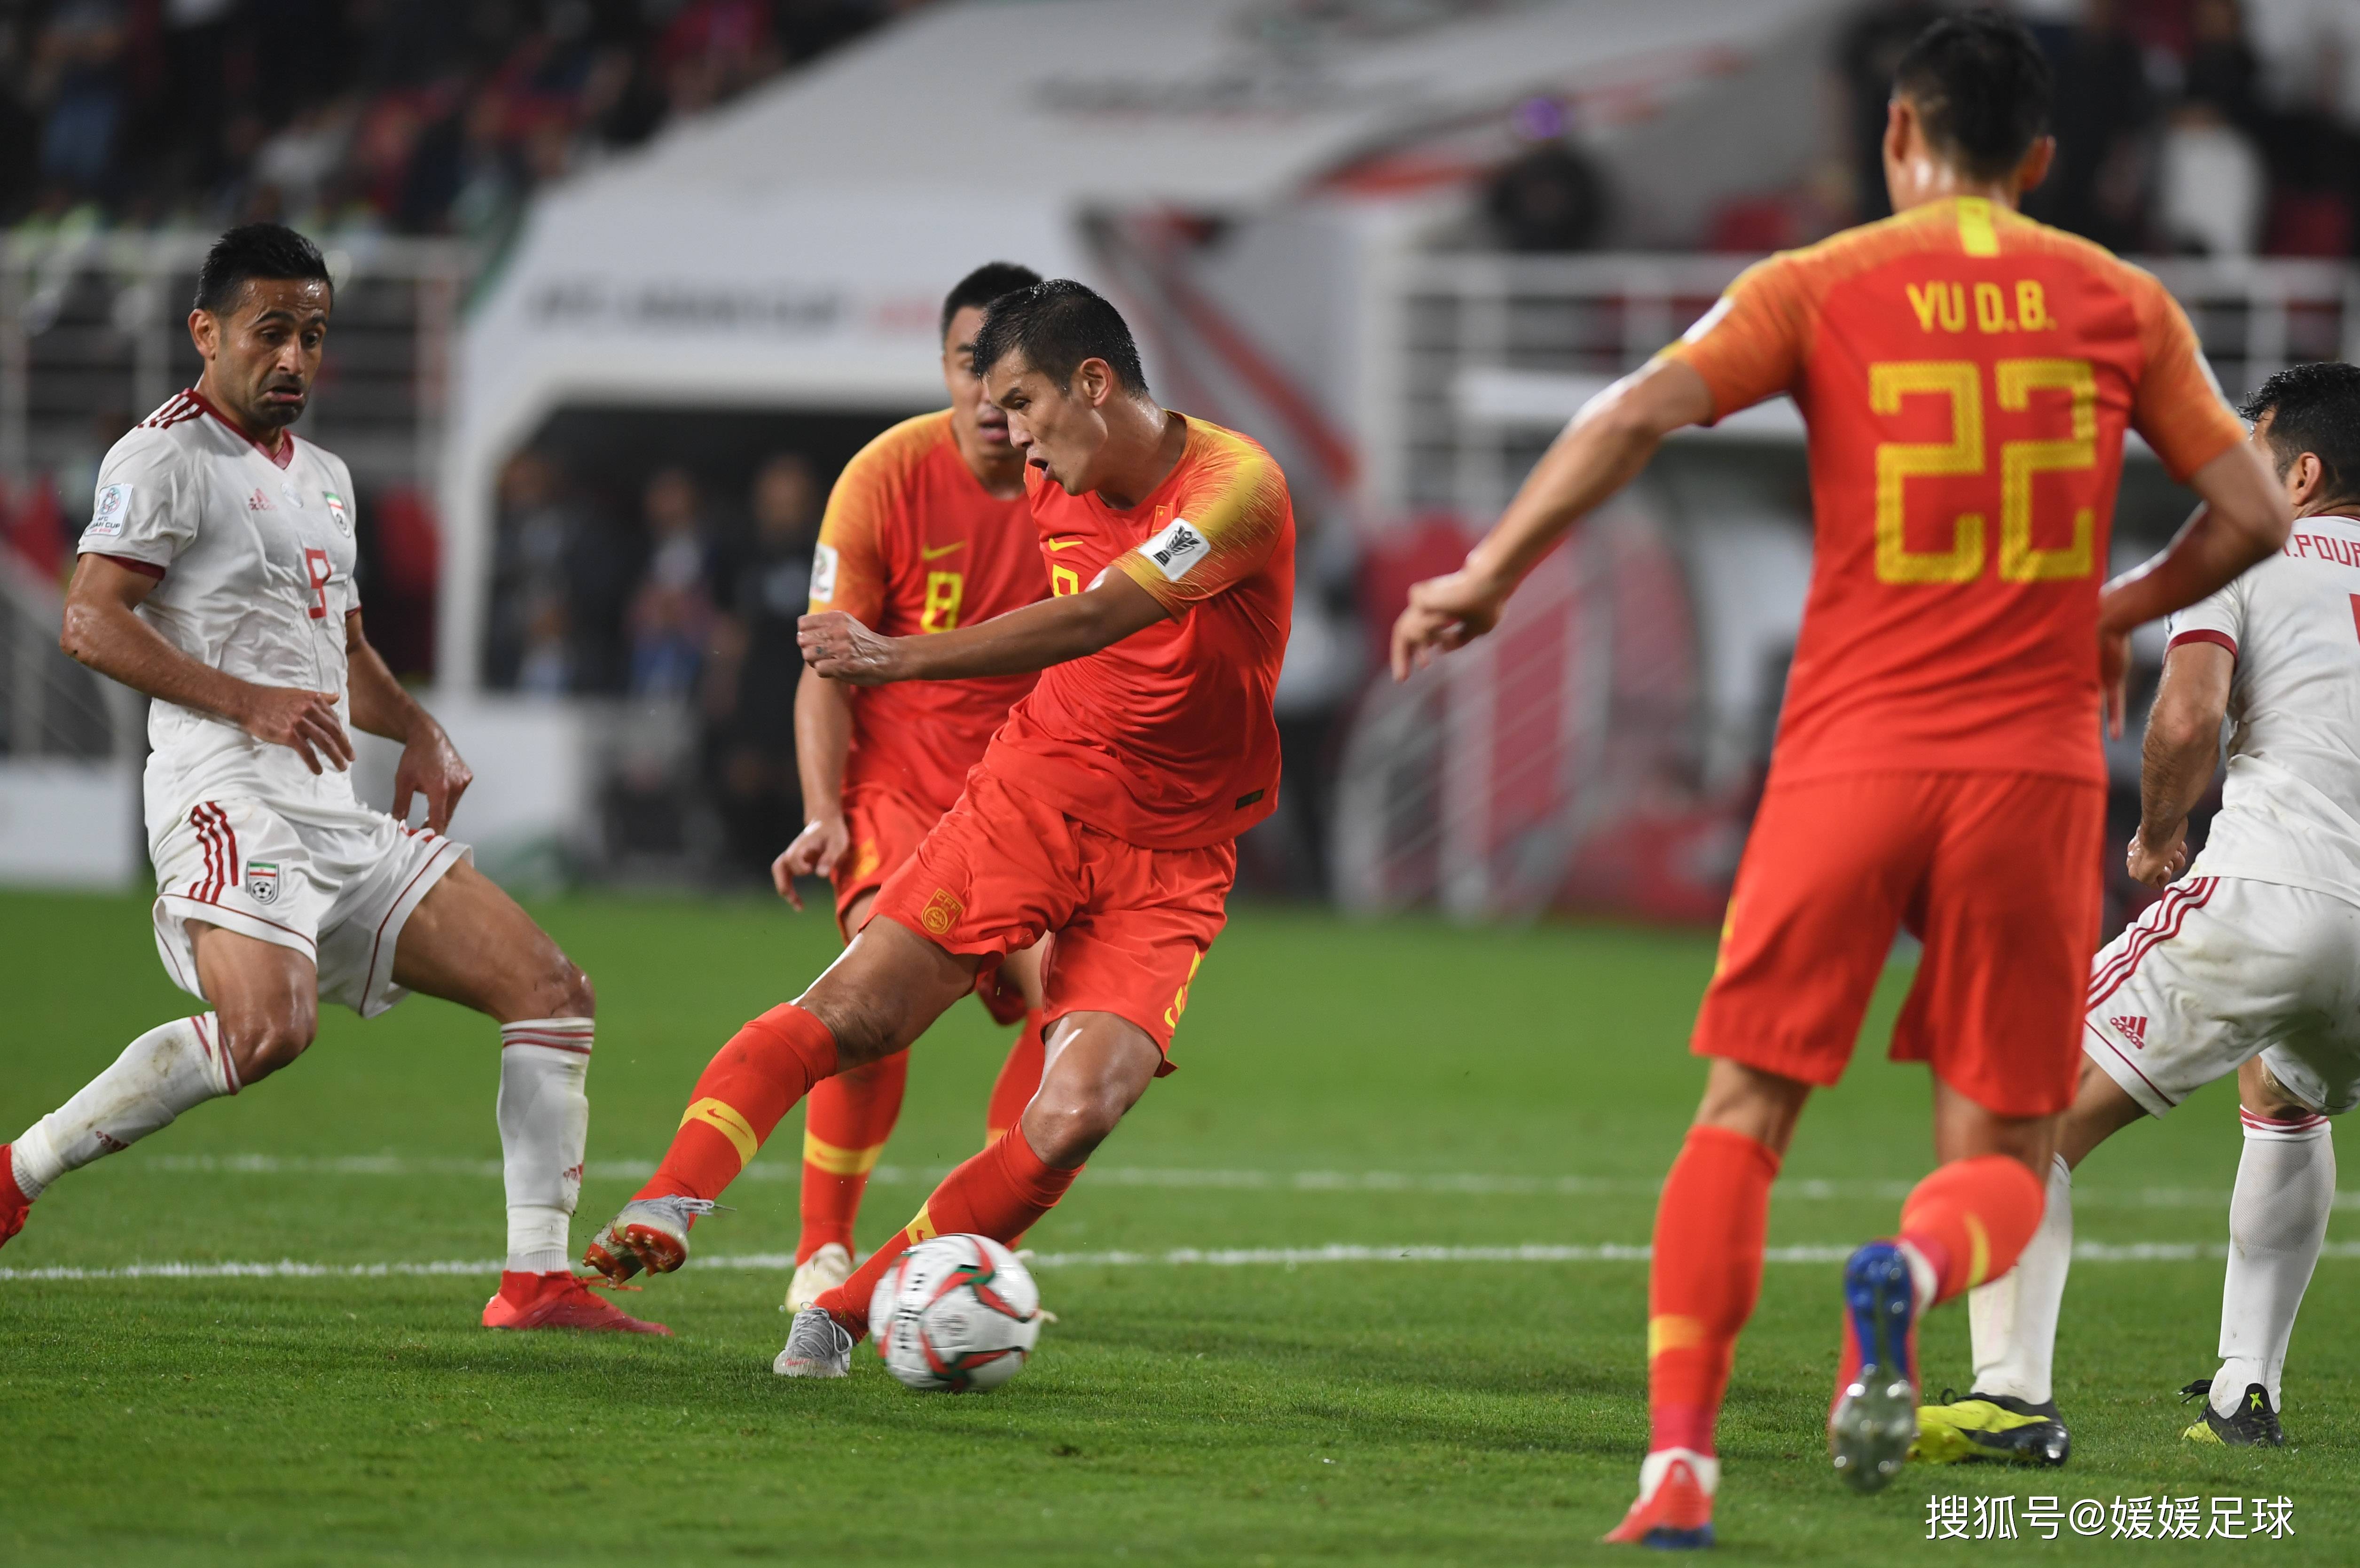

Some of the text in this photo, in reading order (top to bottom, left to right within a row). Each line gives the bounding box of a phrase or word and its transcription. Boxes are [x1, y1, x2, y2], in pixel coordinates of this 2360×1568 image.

[1869, 359, 2097, 584] 22
[305, 548, 331, 619] 9
[921, 570, 963, 633] 8
[2110, 1017, 2145, 1050] adidas
